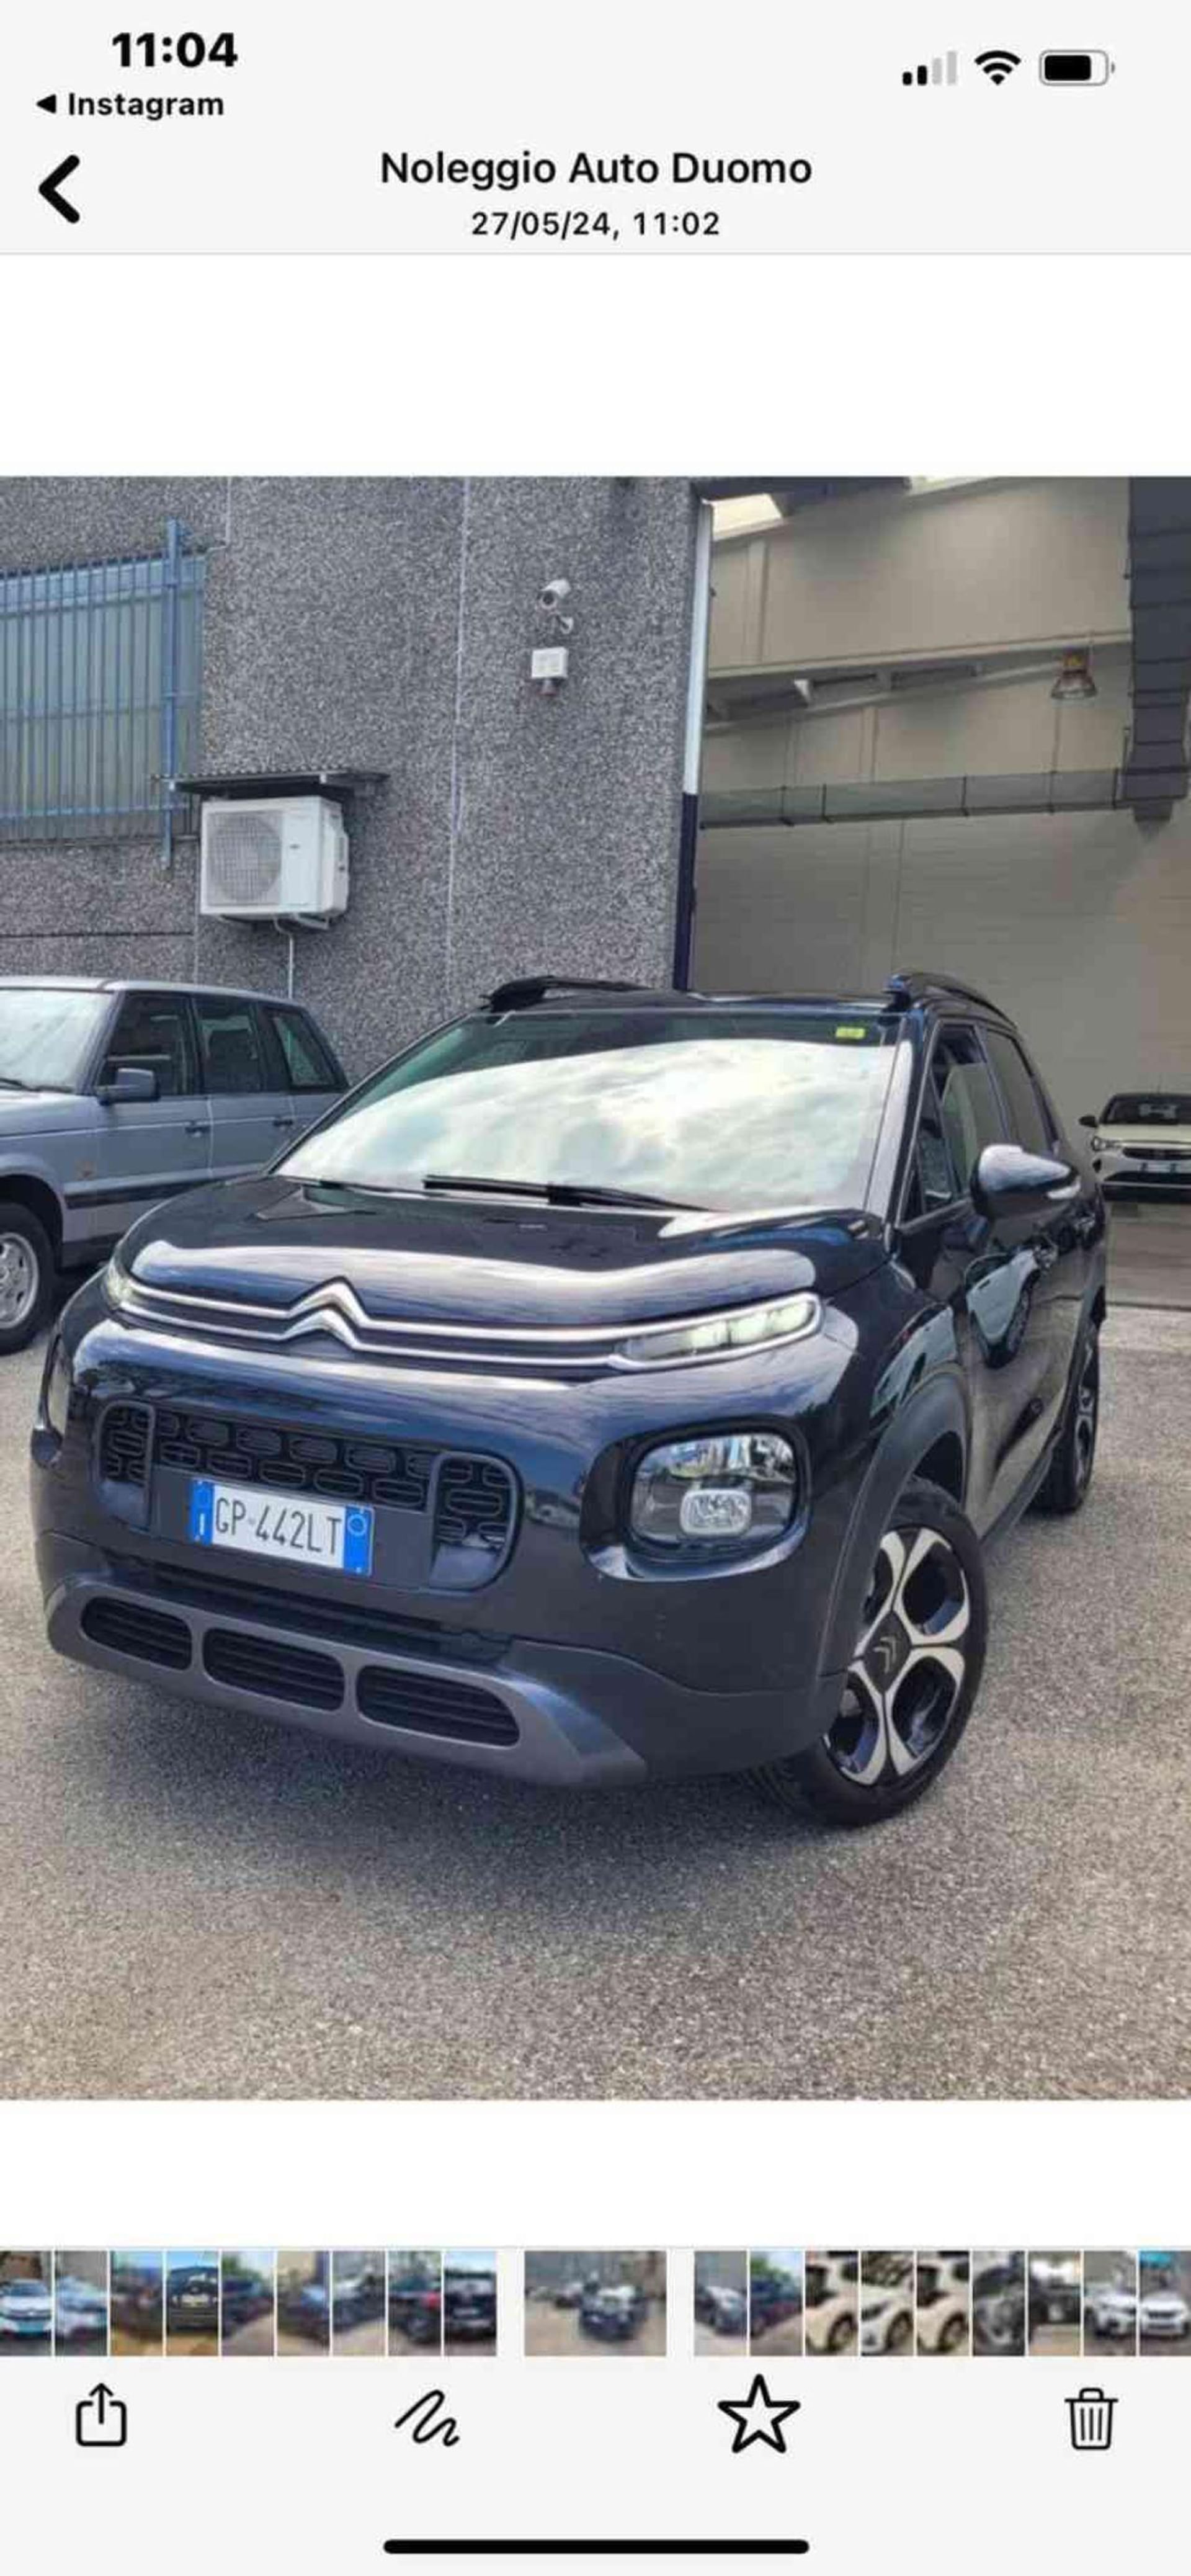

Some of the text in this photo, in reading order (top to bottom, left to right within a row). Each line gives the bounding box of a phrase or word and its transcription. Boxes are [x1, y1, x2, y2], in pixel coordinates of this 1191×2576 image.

[112, 32, 238, 68] 11:04
[68, 92, 225, 121] Instagram
[381, 150, 813, 191] Noleggio Auto Duomo
[471, 211, 720, 241] 27/05/24, 11:02
